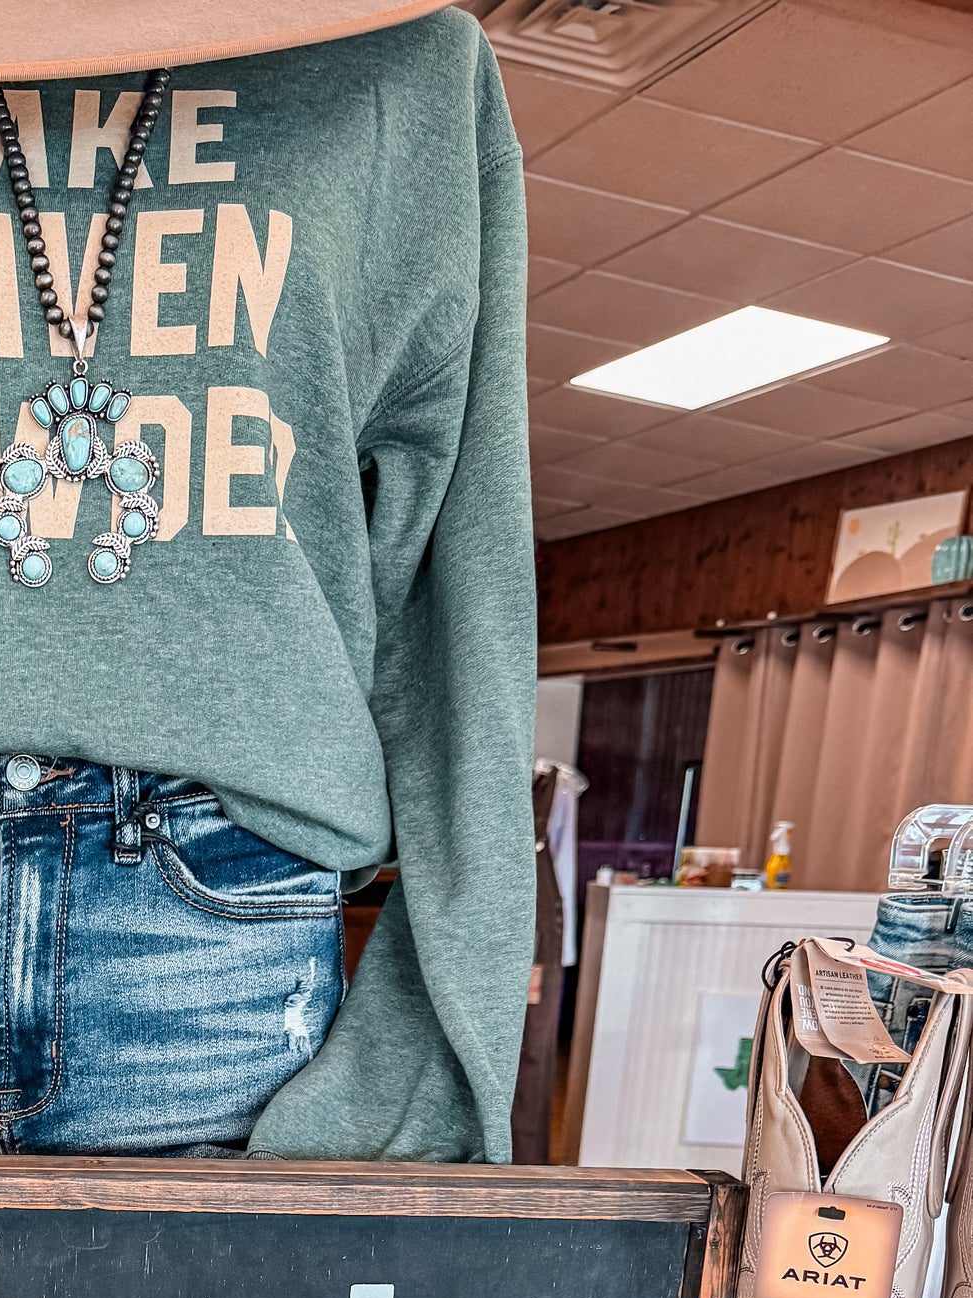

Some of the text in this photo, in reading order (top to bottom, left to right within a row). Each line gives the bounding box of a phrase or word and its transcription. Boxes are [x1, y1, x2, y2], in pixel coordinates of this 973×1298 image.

[815, 969, 864, 981] ARTISAN LEATHER
[781, 1268, 866, 1290] ARIAT
